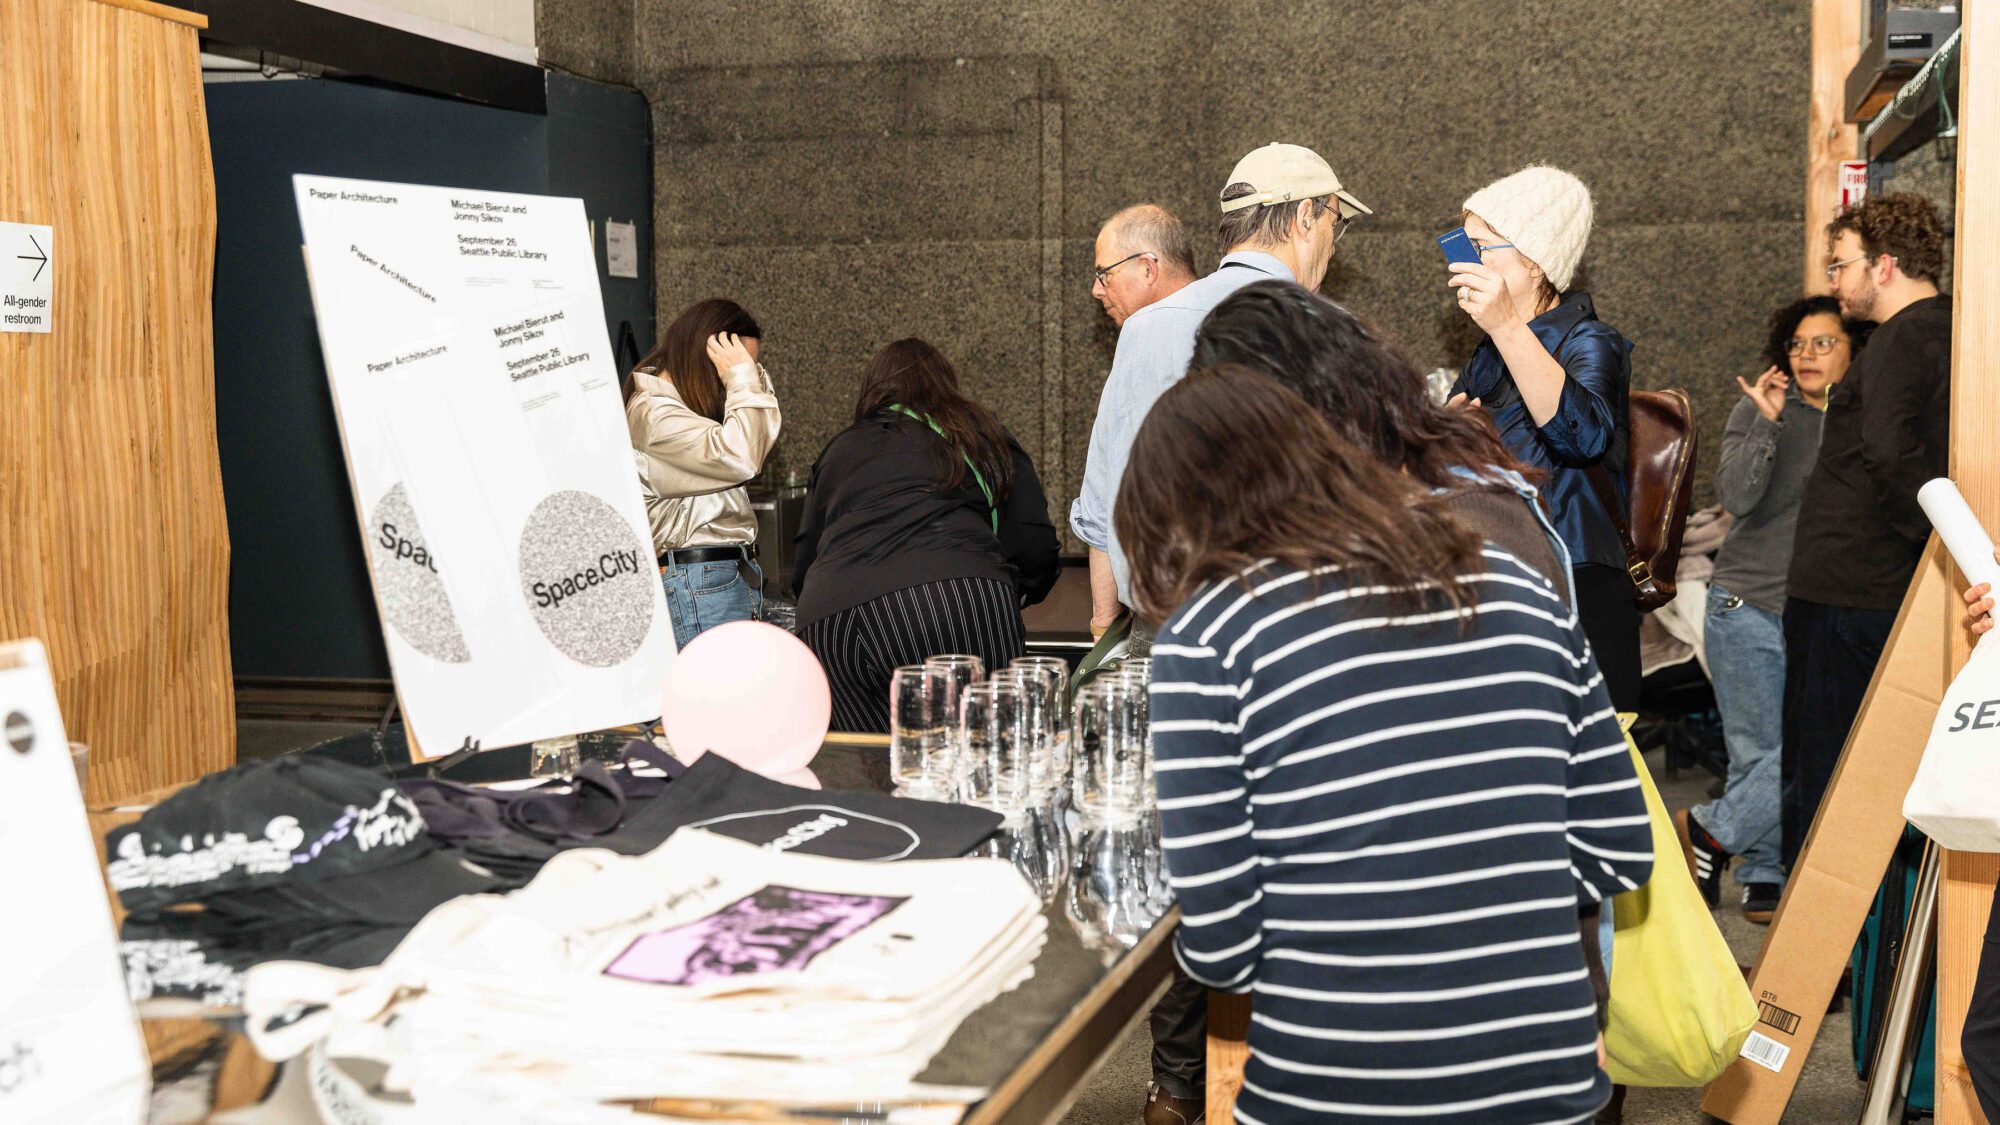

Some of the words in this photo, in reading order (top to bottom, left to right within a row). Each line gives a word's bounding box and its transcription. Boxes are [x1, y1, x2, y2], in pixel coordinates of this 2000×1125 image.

[309, 188, 338, 200] Paper
[340, 191, 398, 204] Architecture
[450, 199, 485, 211] Michael
[486, 202, 510, 214] Bierut
[512, 206, 527, 214] and
[454, 212, 479, 223] Jonny
[457, 234, 504, 246] September
[460, 246, 490, 257] Seattle
[491, 248, 518, 258] Public
[519, 250, 547, 261] Library
[350, 244, 378, 266] Paper
[380, 263, 437, 303] Architecture
[4, 294, 47, 309] All-gender
[4, 314, 42, 325] restroom
[493, 321, 525, 337] Michael
[525, 315, 549, 329] Bierut
[550, 309, 565, 321] and
[499, 336, 523, 348] Jonny
[367, 362, 393, 374] Paper
[395, 345, 448, 366] Architecture
[506, 352, 549, 371] September
[550, 347, 561, 358] 26
[510, 366, 538, 382] Seattle
[538, 360, 562, 373] Public
[562, 353, 590, 366] Library
[533, 550, 638, 608] Space.City
[1948, 700, 2000, 732] SE
[1761, 990, 1778, 1002] BT6
